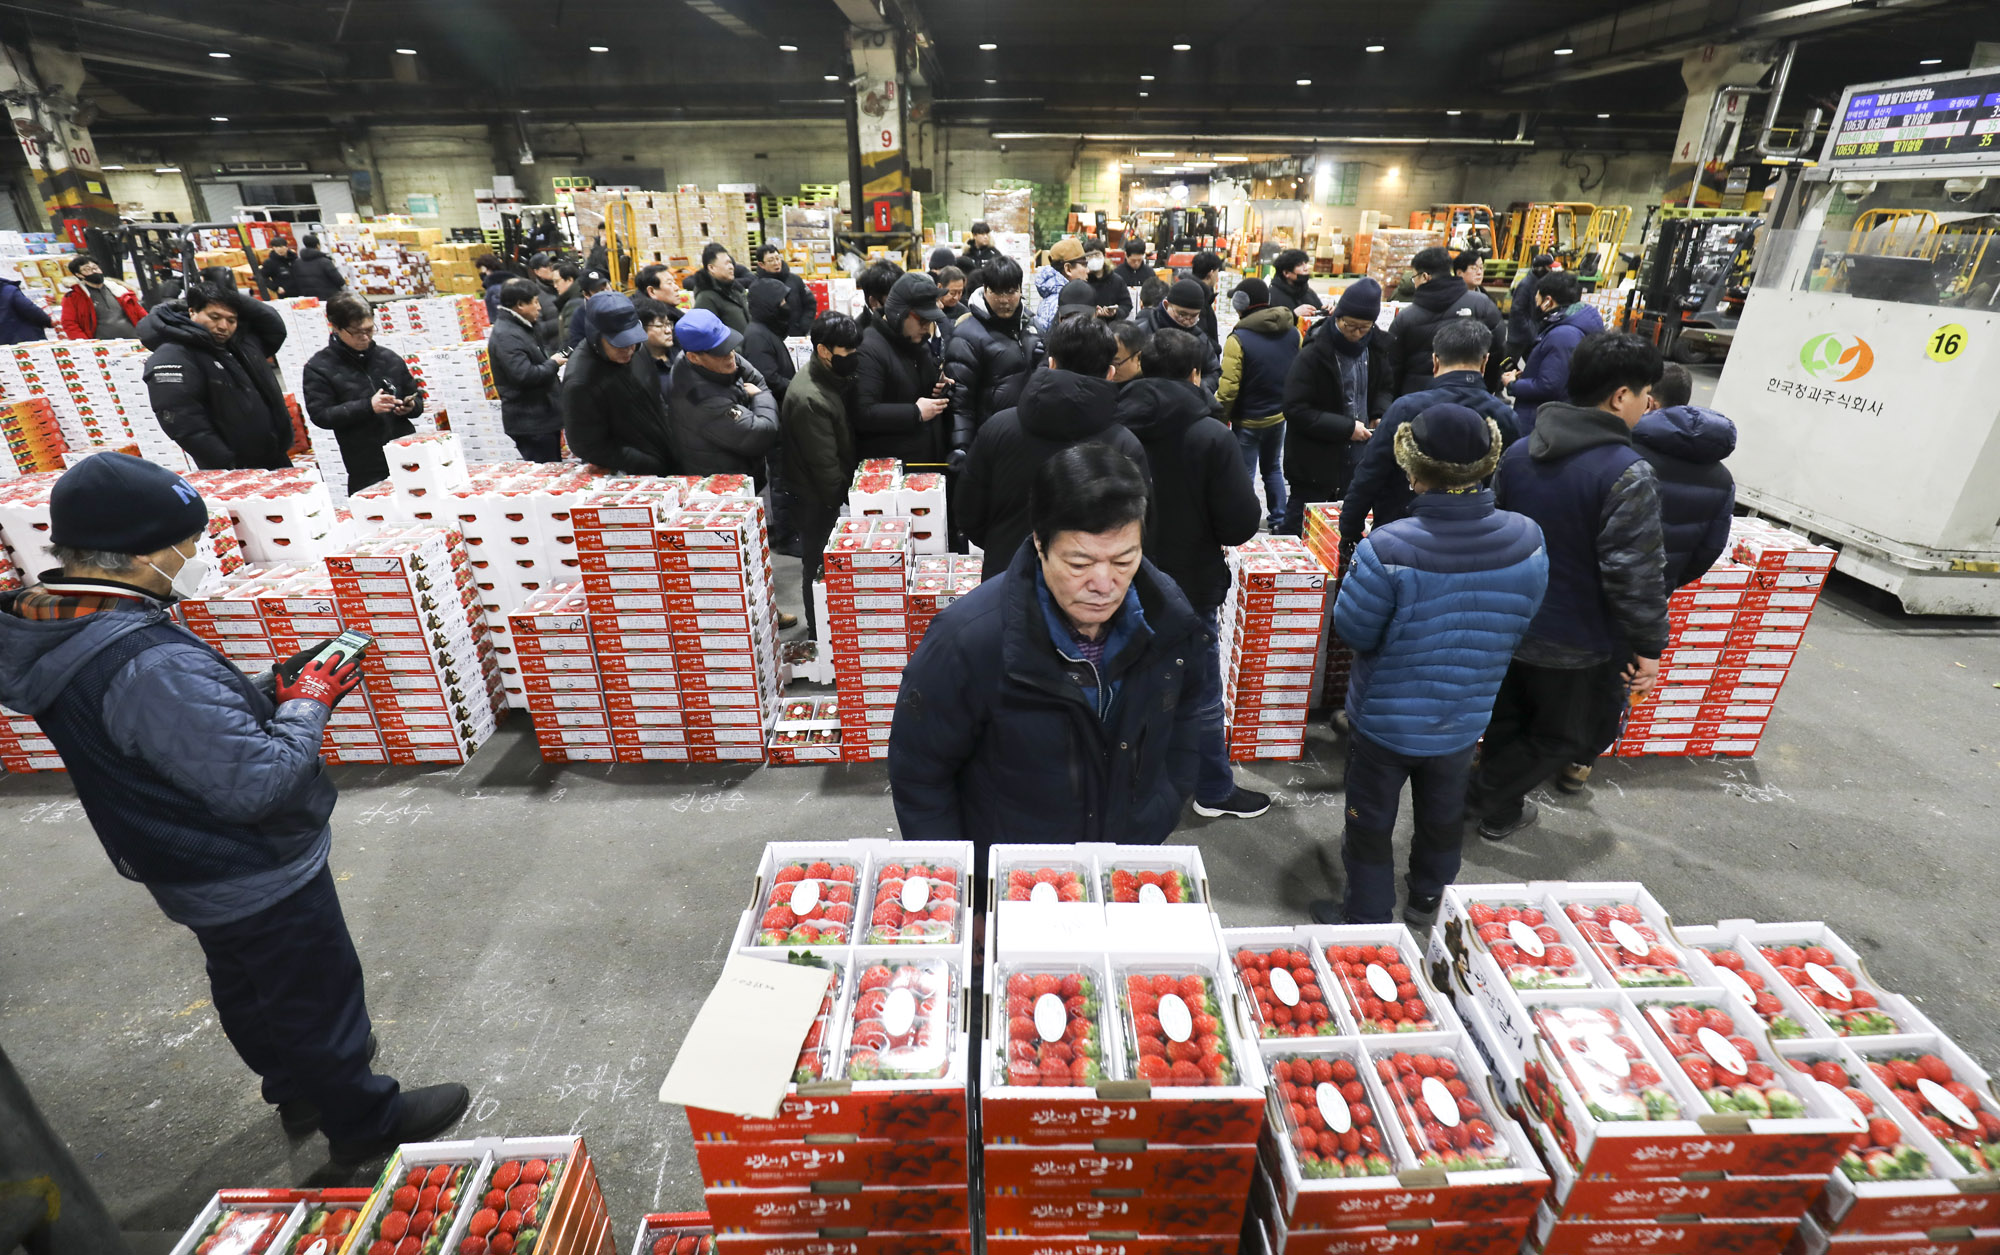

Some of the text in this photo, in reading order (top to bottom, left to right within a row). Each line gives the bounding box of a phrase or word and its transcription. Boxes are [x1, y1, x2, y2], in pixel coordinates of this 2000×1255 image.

[1843, 119, 1866, 131] 10630
[1955, 108, 1963, 121] 1
[881, 130, 892, 148] 9
[1834, 144, 1857, 156] 10650
[1944, 136, 1951, 149] 1
[1978, 133, 1994, 147] 35
[71, 147, 91, 165] 10
[1681, 141, 1691, 160] 4
[1706, 156, 1718, 174] 4
[1684, 240, 1695, 268] TOYOTA
[1933, 333, 1962, 355] 16
[1766, 377, 1884, 417] 한국청과주식회사
[783, 1100, 839, 1120] 딸기
[1081, 1105, 1137, 1125] 딸기
[790, 1149, 845, 1169] 딸기
[1681, 1141, 1735, 1160] 딸기
[1079, 1157, 1133, 1176] 딸기
[1384, 1193, 1435, 1211] 딸기
[1658, 1186, 1710, 1203] 딸기
[798, 1198, 851, 1216] 딸기
[1077, 1201, 1129, 1219] 딸기
